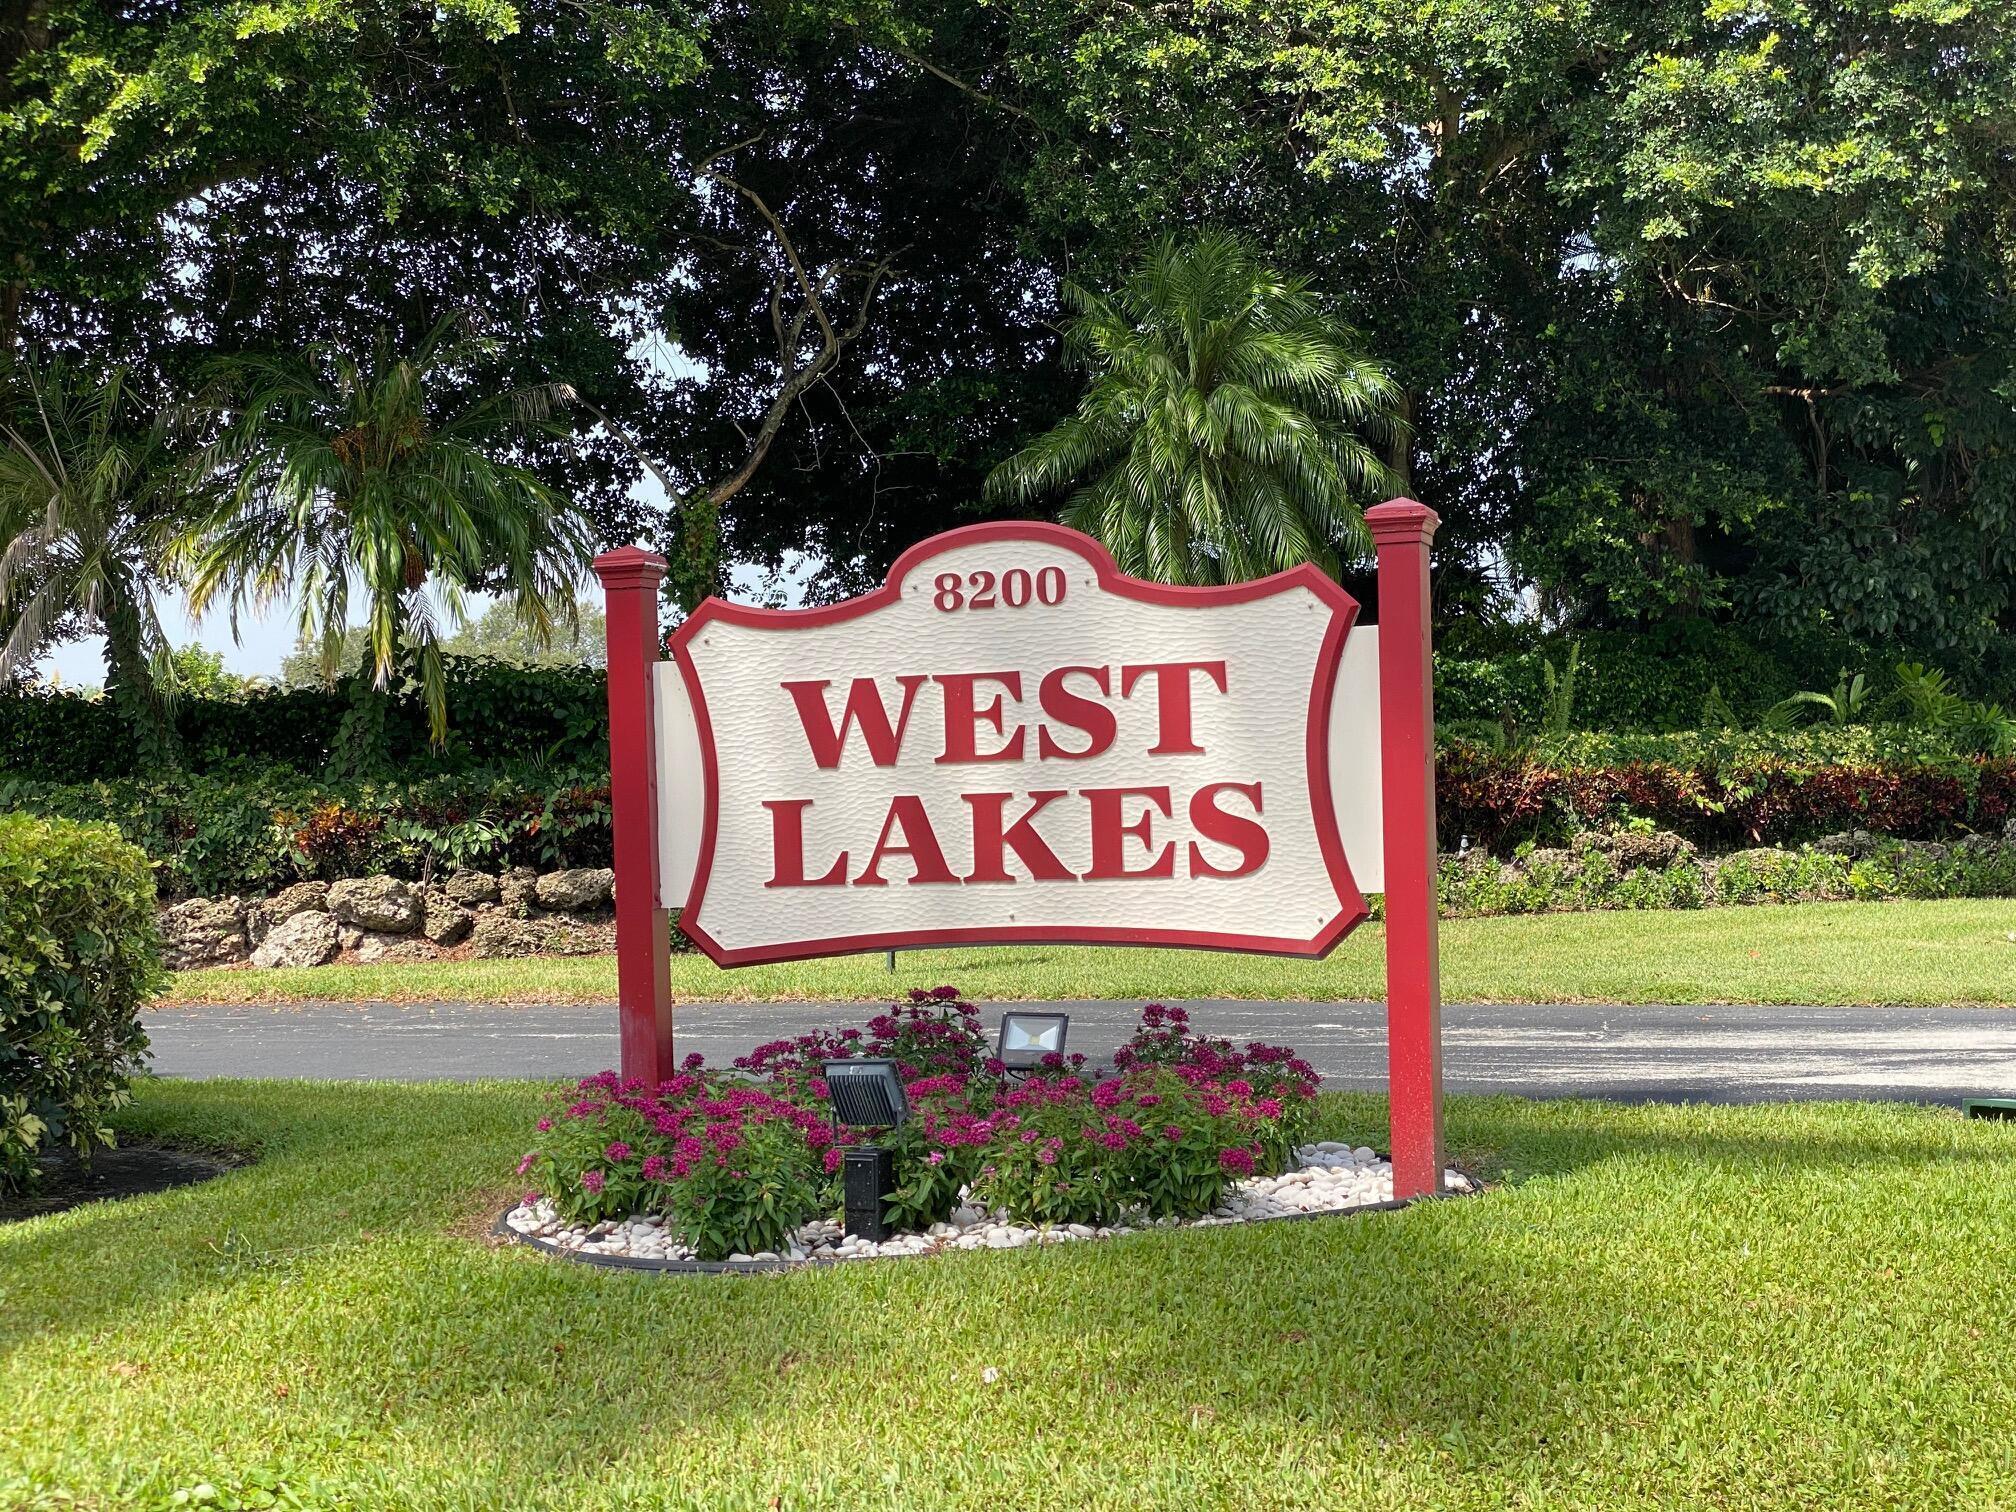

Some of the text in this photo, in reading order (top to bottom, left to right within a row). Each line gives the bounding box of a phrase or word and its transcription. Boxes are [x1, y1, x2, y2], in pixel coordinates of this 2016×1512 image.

[933, 566, 1067, 612] 8200
[781, 661, 1228, 769] WEST
[762, 781, 1270, 889] LAKES
